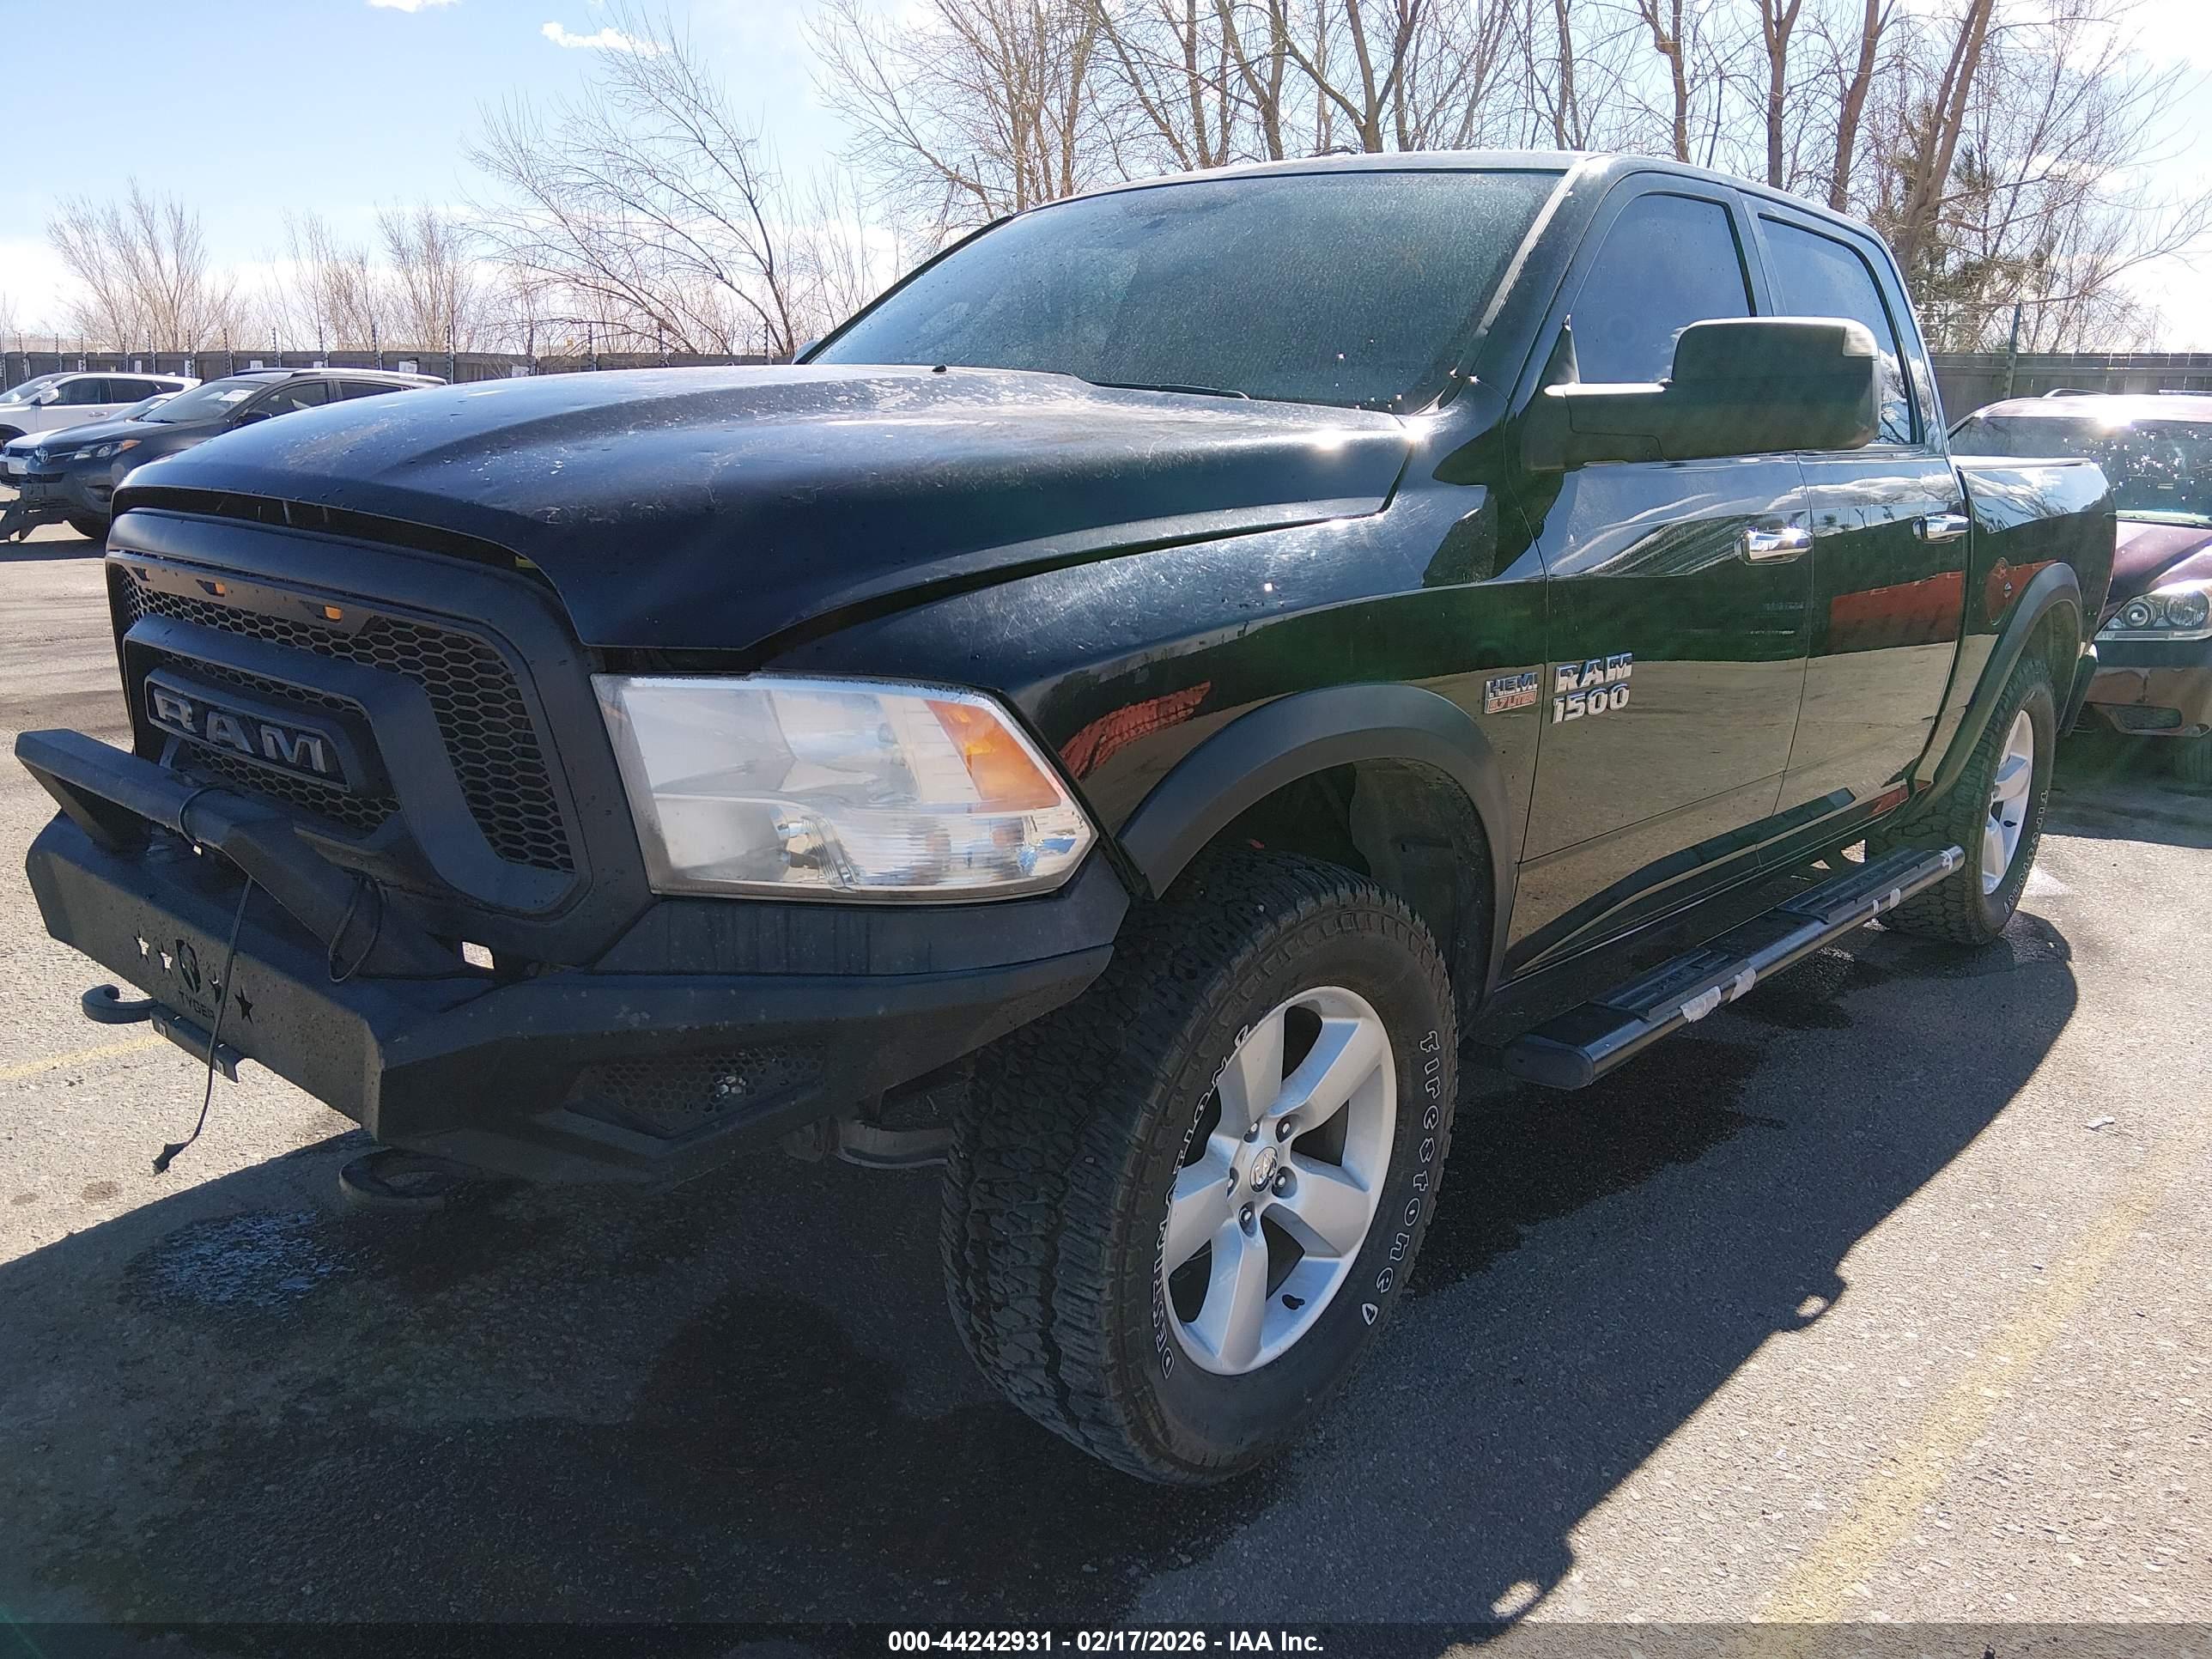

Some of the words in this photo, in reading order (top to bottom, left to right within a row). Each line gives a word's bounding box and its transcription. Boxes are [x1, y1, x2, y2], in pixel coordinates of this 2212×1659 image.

[1486, 672, 1539, 698] HEMI
[1553, 653, 1633, 694] RAM
[1489, 697, 1504, 712] 5.7
[1552, 683, 1631, 724] 1500
[153, 689, 327, 774] RAM
[178, 989, 216, 1024] TYGER
